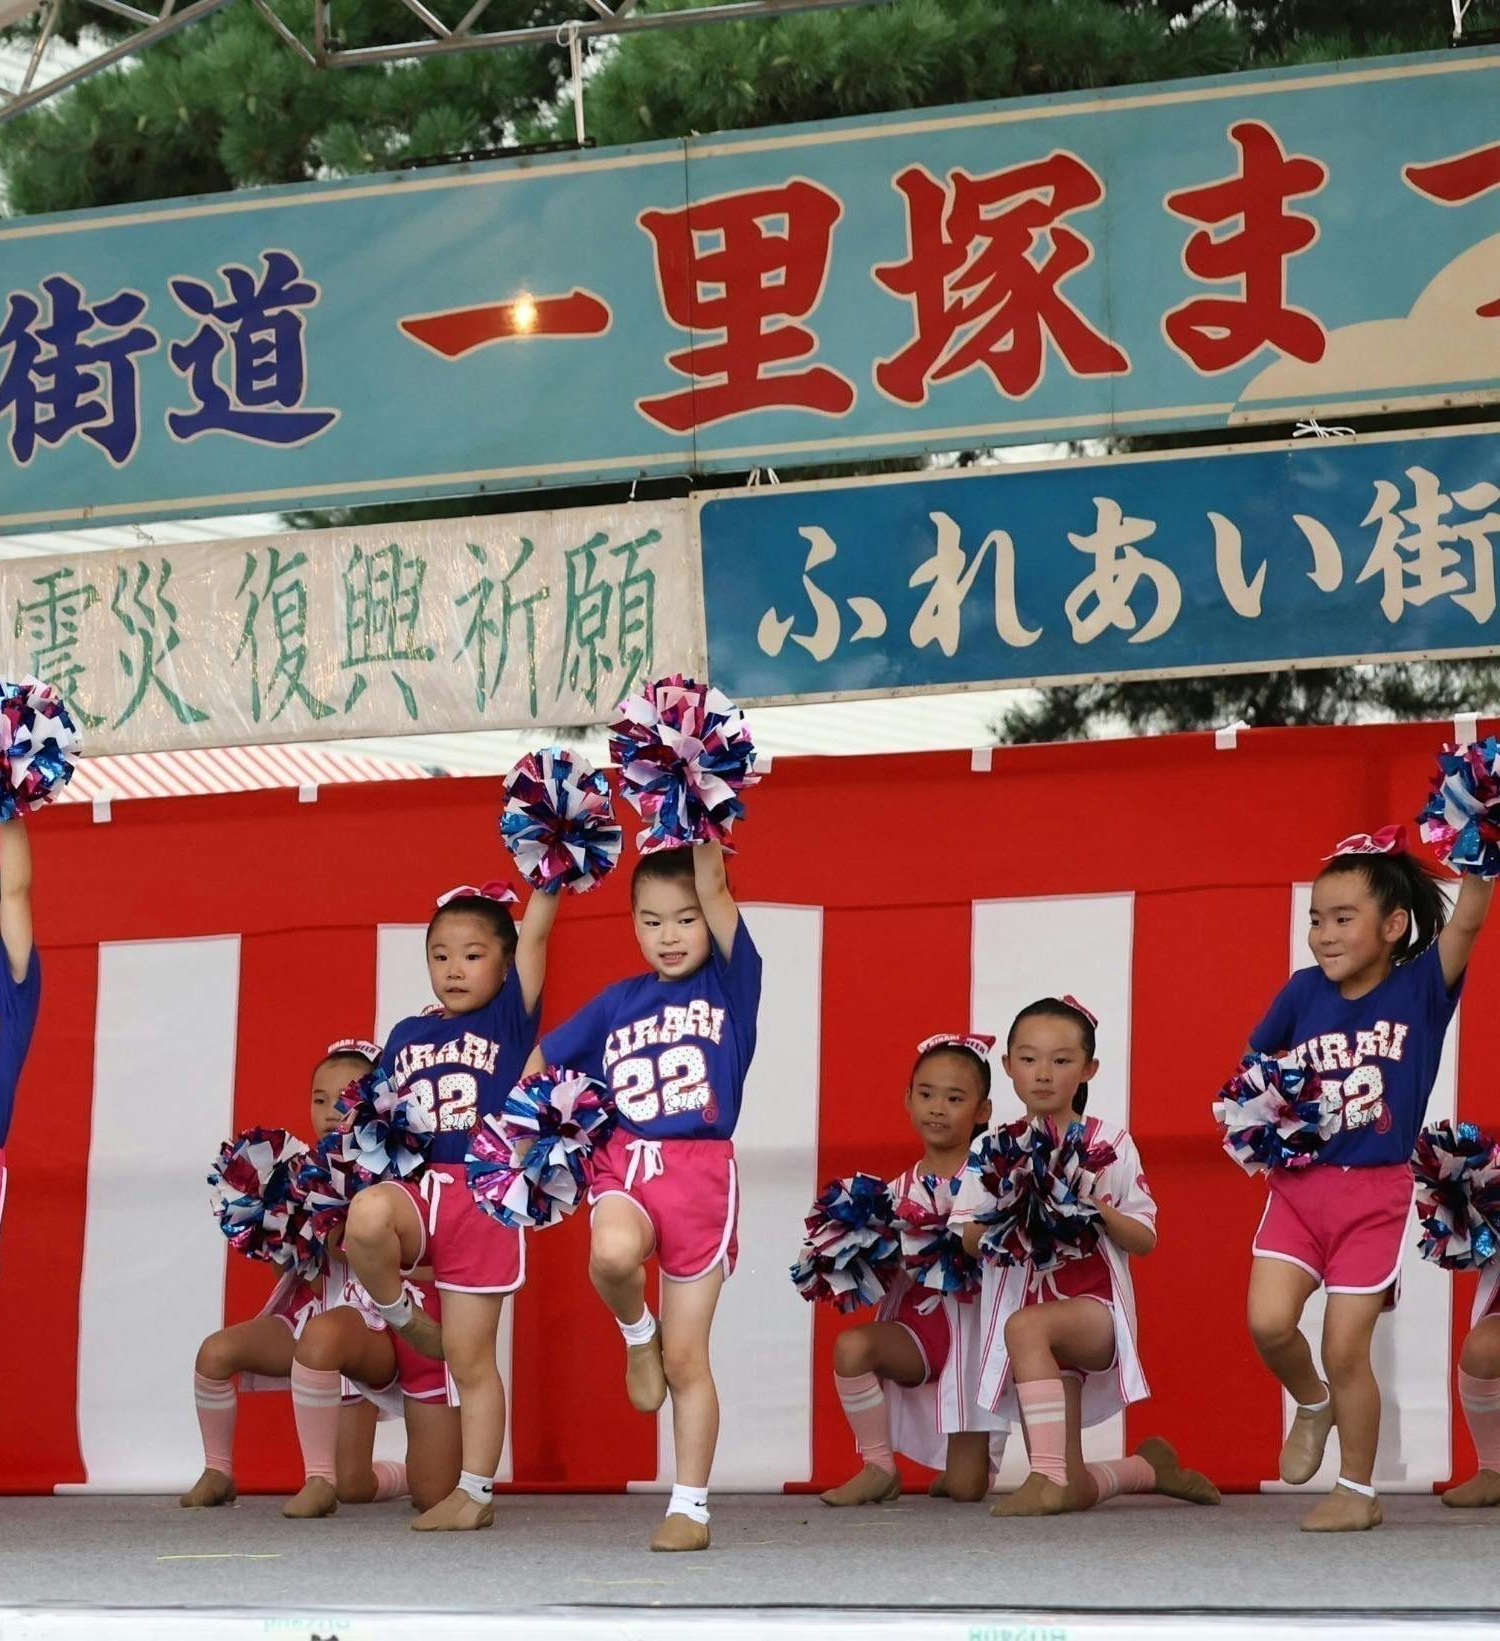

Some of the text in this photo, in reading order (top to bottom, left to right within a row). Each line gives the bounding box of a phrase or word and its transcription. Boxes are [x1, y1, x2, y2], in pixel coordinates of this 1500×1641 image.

[757, 465, 1500, 662] ふれあい街
[612, 1046, 710, 1122] 22
